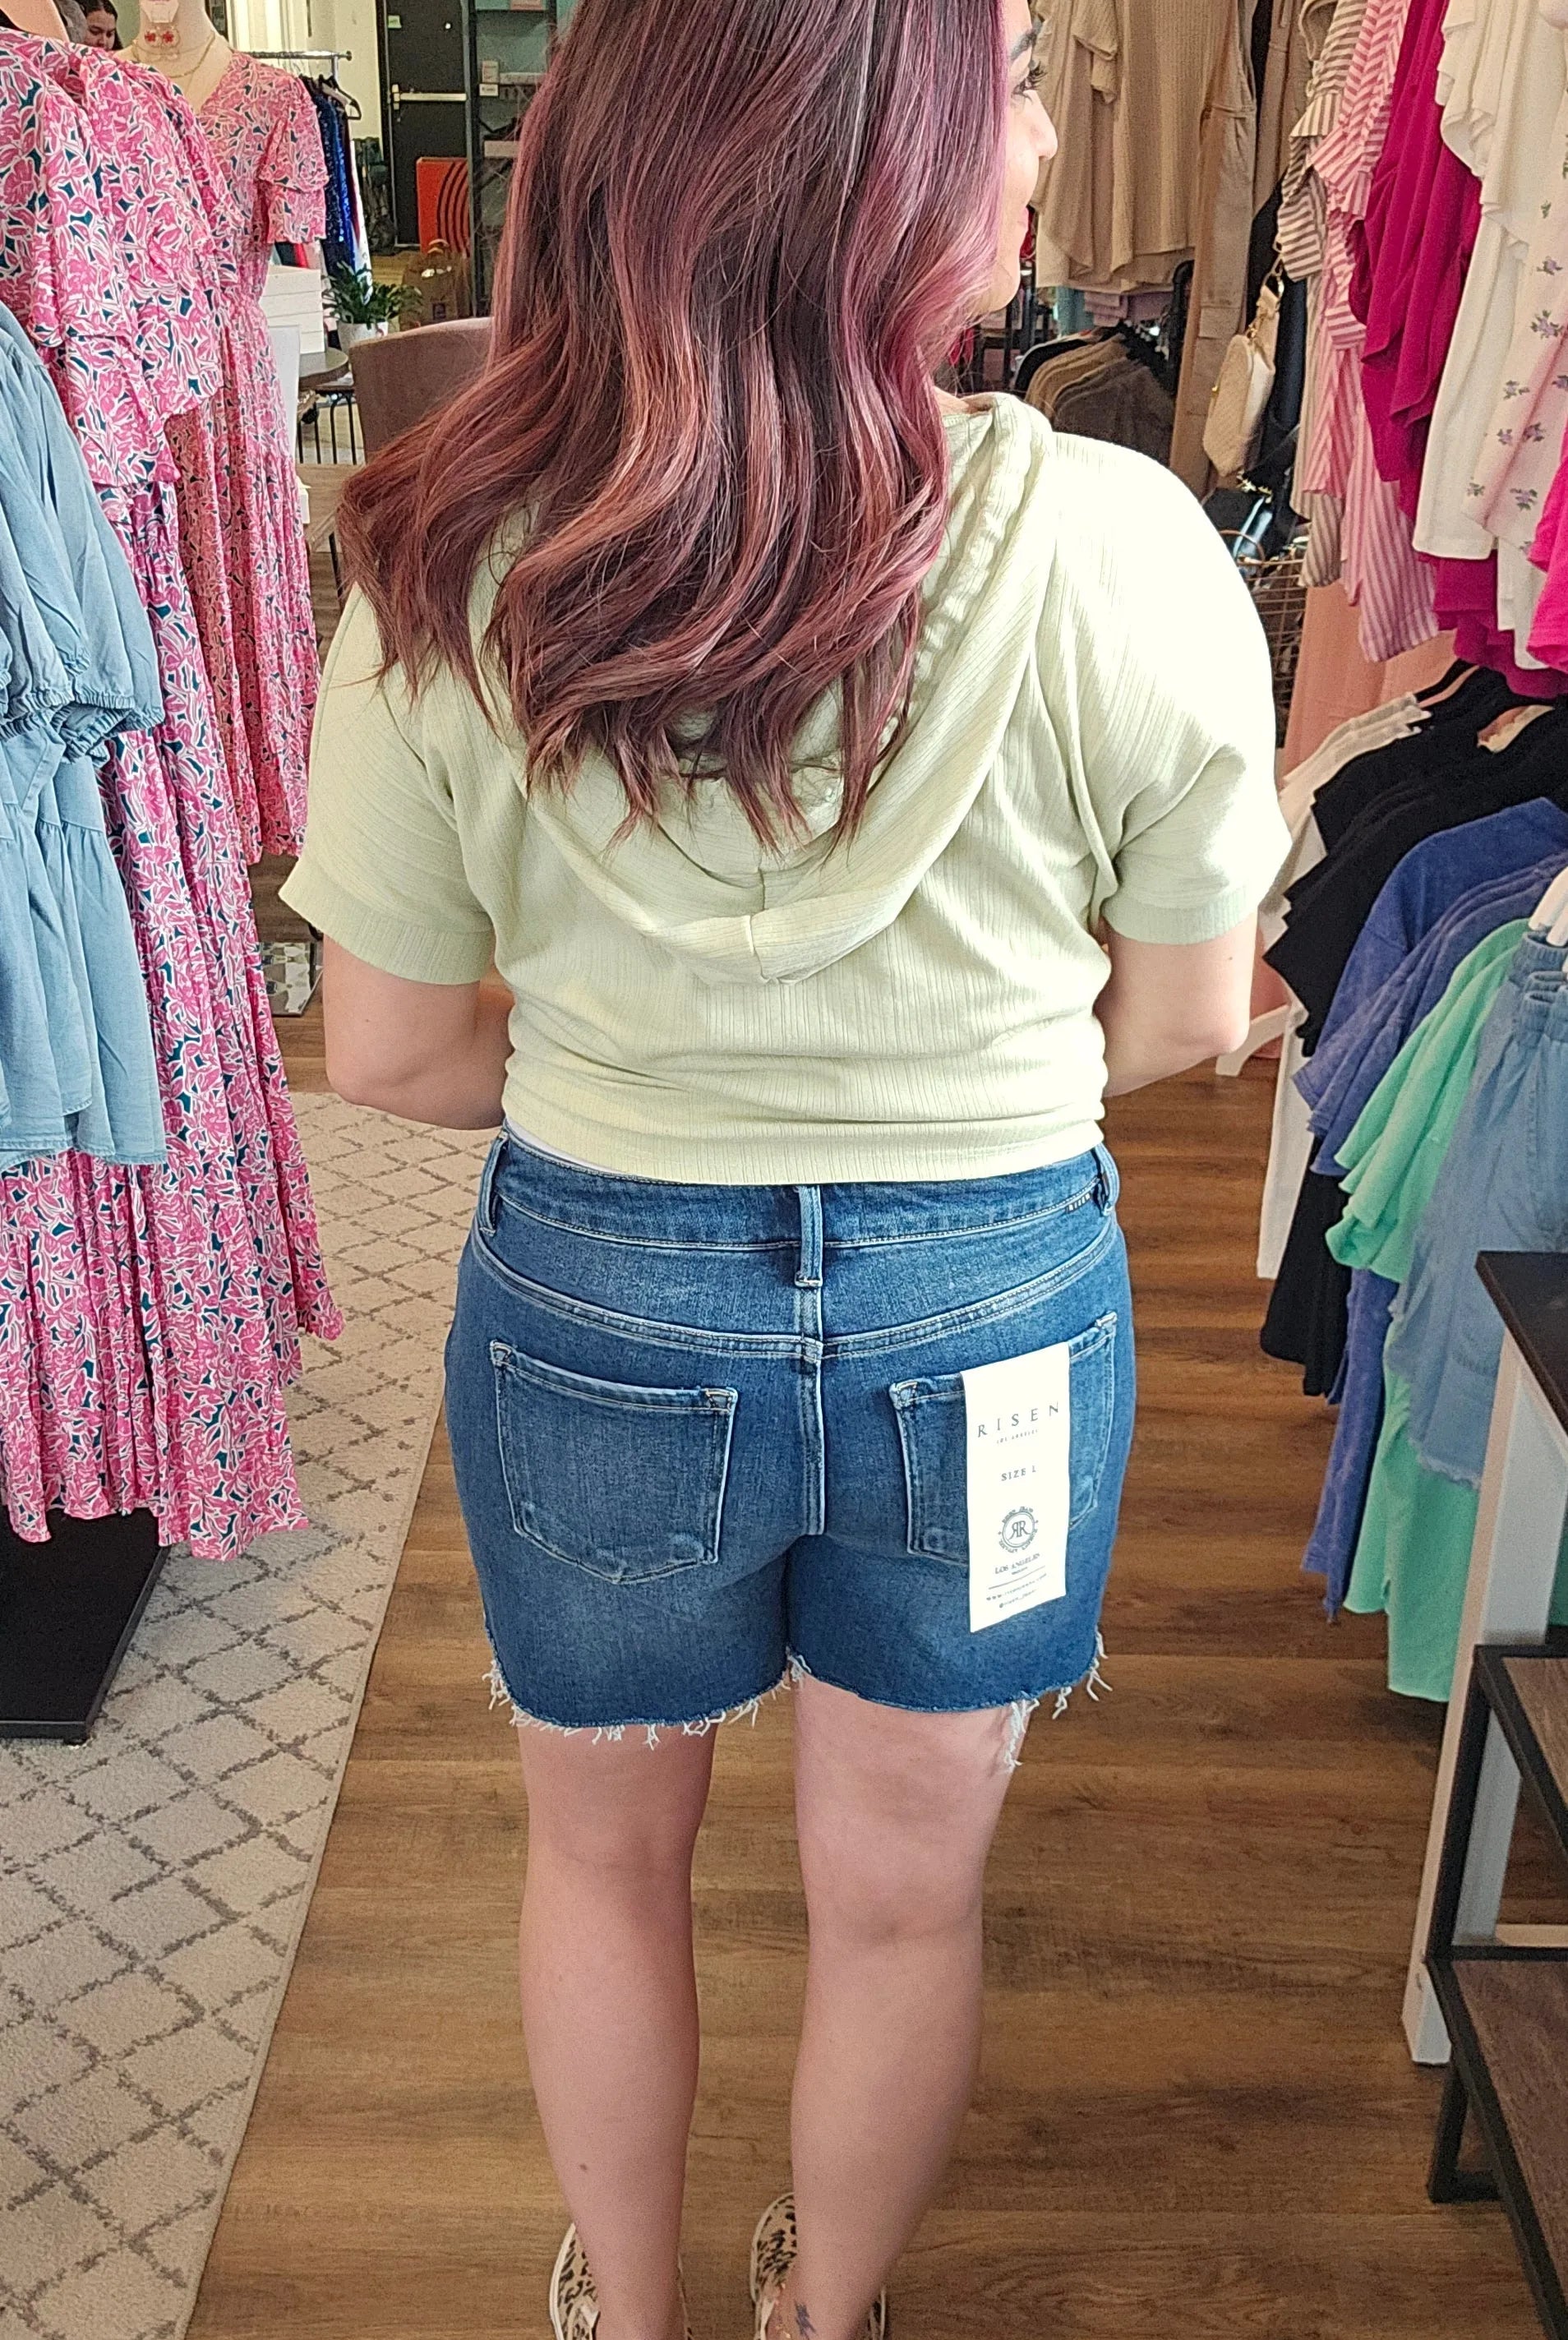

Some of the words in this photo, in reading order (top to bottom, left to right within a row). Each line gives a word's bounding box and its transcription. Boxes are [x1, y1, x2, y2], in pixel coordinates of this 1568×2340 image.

[977, 1401, 1058, 1438] RISEN
[1001, 1467, 1026, 1482] SIZE
[994, 1564, 1008, 1574] LOS
